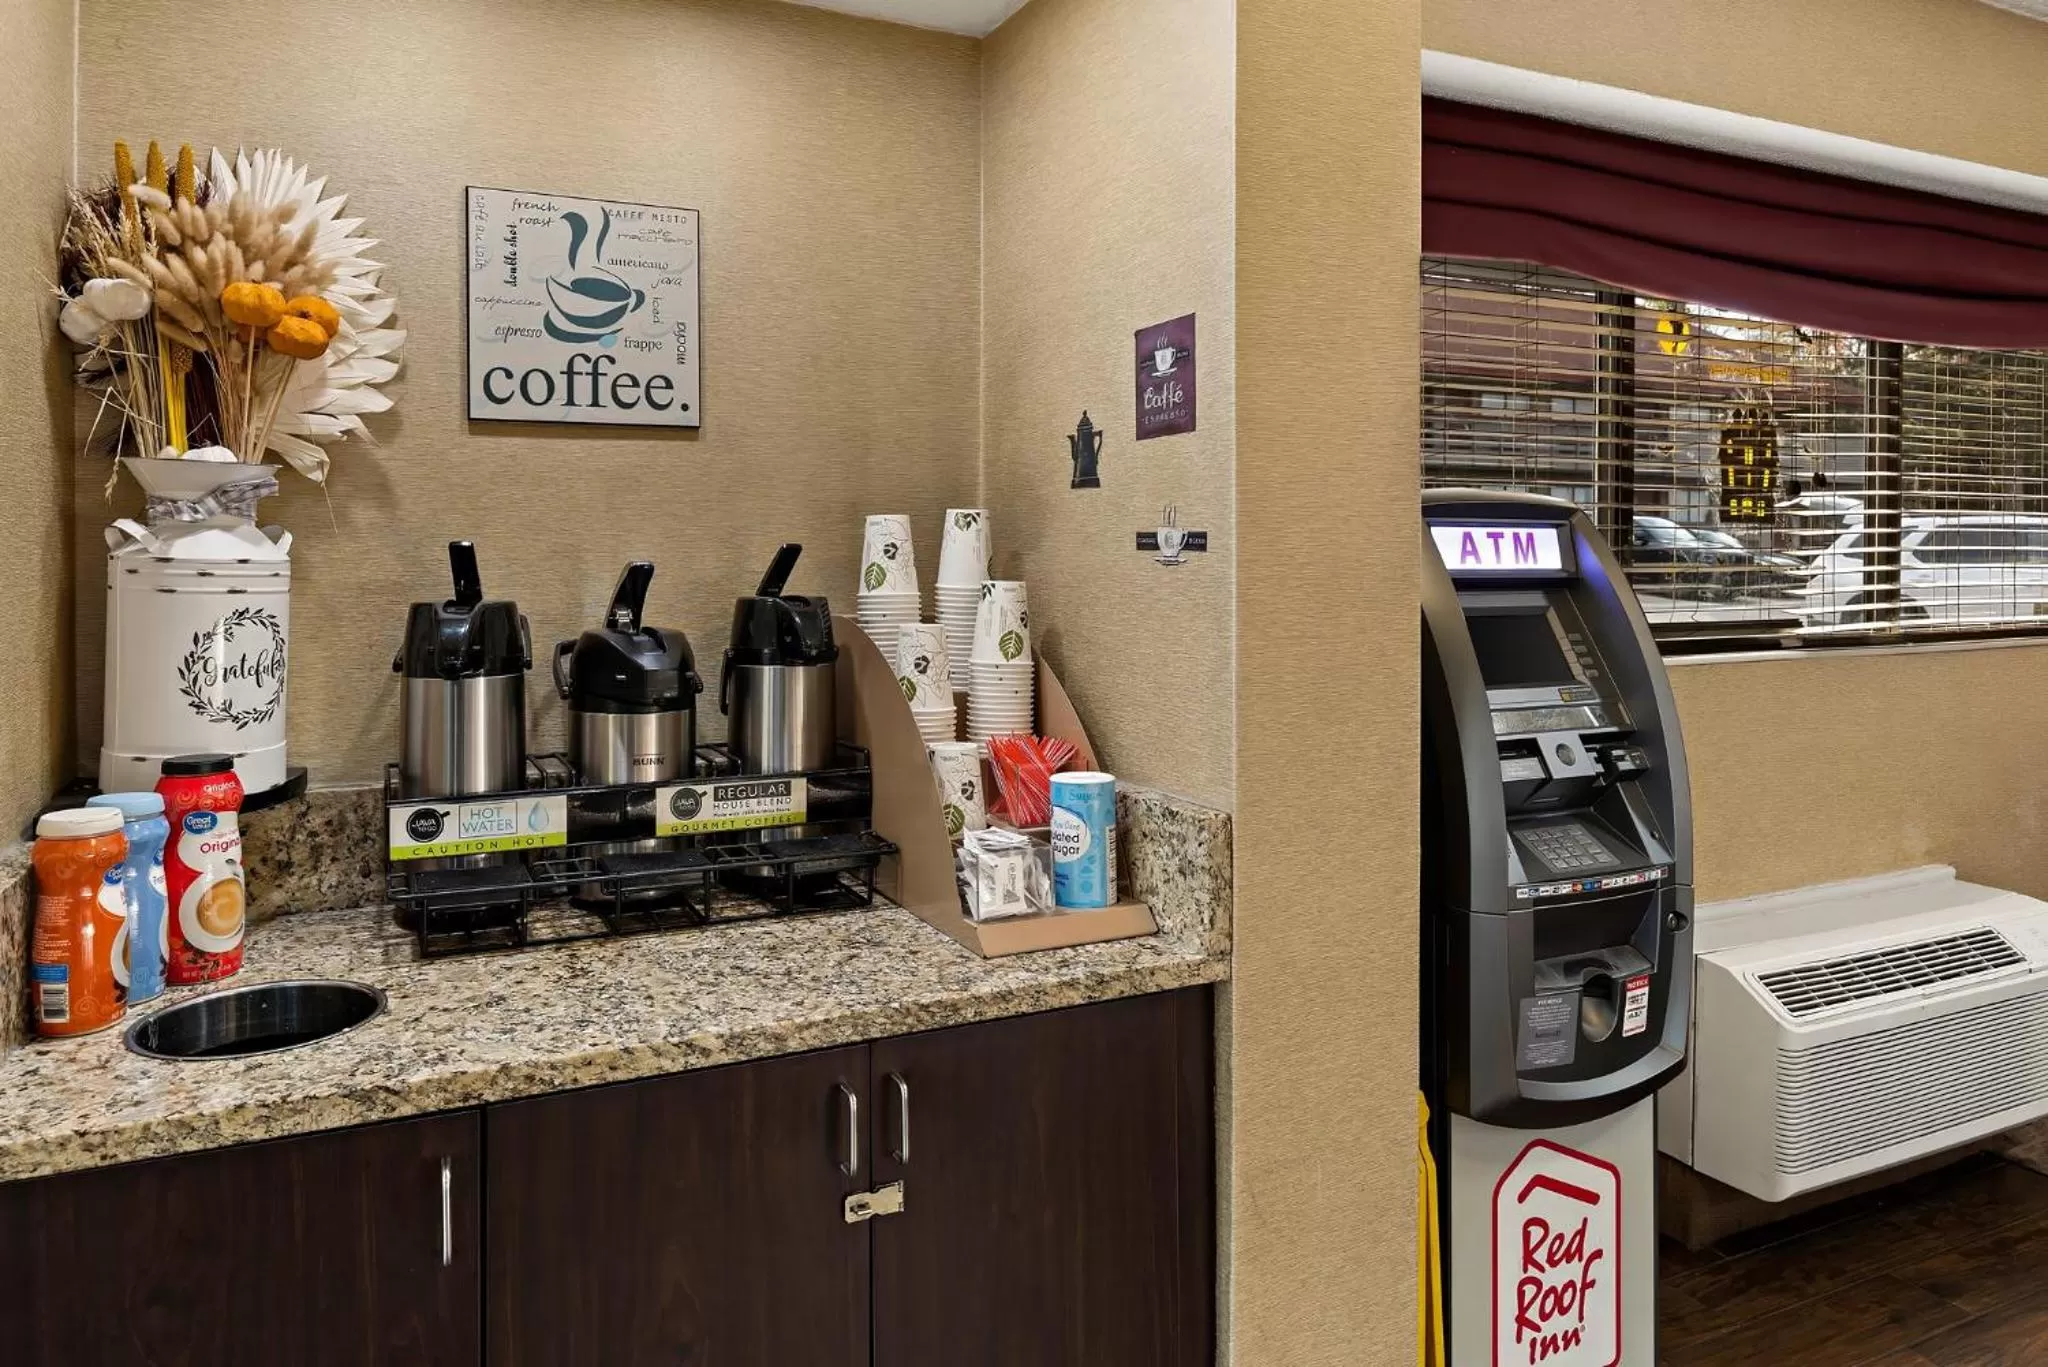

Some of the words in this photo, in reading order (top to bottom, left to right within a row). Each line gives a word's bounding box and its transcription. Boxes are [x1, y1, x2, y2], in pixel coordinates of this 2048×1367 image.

[511, 198, 560, 212] french
[519, 217, 554, 228] roast
[503, 223, 517, 248] shot
[503, 250, 517, 287] double
[607, 256, 669, 270] americano
[651, 275, 682, 289] java
[494, 324, 543, 344] espresso
[624, 336, 663, 352] frappe
[673, 321, 687, 365] mocha
[482, 353, 690, 412] coffee.
[1460, 530, 1539, 565] ATM
[633, 757, 666, 767] BUNN
[718, 783, 787, 799] REGULAR
[713, 801, 750, 810] HOUSE
[757, 797, 792, 807] BLEND
[470, 806, 503, 821] HOT
[462, 819, 514, 834] WATER
[671, 820, 735, 833] GOURMET
[413, 841, 499, 857] CAUTION
[512, 836, 548, 847] HOT
[1522, 1216, 1588, 1274] Red
[1515, 1248, 1603, 1344] Roof
